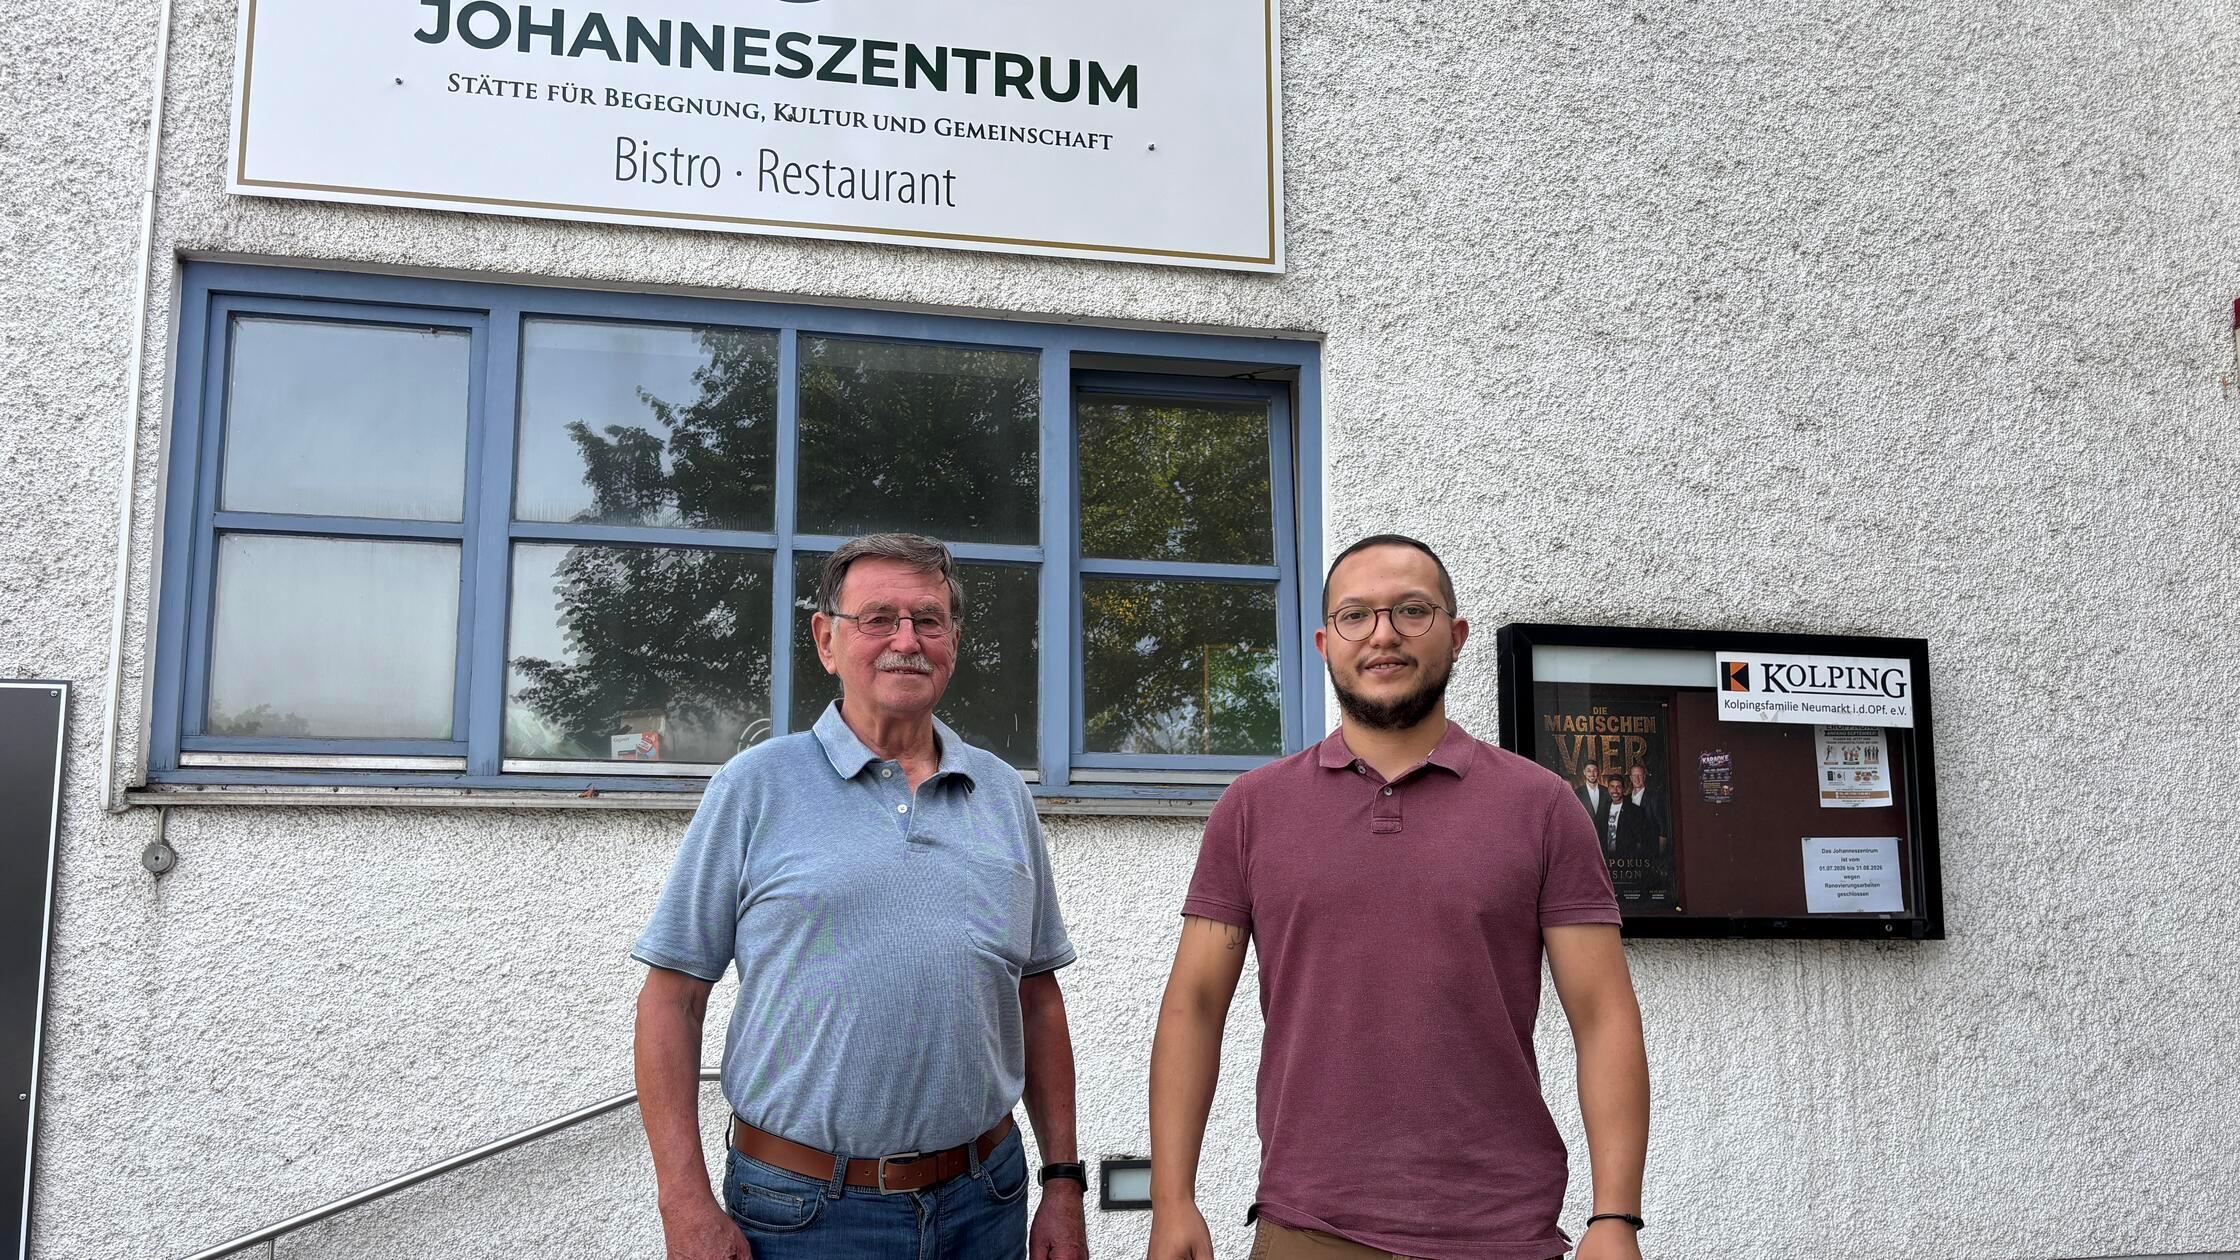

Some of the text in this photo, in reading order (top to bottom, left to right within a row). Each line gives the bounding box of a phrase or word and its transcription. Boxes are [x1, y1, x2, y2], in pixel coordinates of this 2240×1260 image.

[413, 0, 1139, 109] JOHANNESZENTRUM
[447, 73, 1114, 151] STÄTTE FÜR BEGEGNUNG, KULTUR UND GEMEINSCHAFT
[615, 136, 721, 189] Bistro
[758, 148, 957, 208] Restaurant
[1760, 663, 1907, 699] KOLPING
[1543, 714, 1657, 734] MAGISCHEN
[1592, 706, 1608, 715] DIE
[1724, 699, 1799, 712] Kolpingsfamilie
[1801, 702, 1851, 714] Neumarkt
[1890, 706, 1907, 716] e.V.
[1552, 734, 1648, 776] VIER
